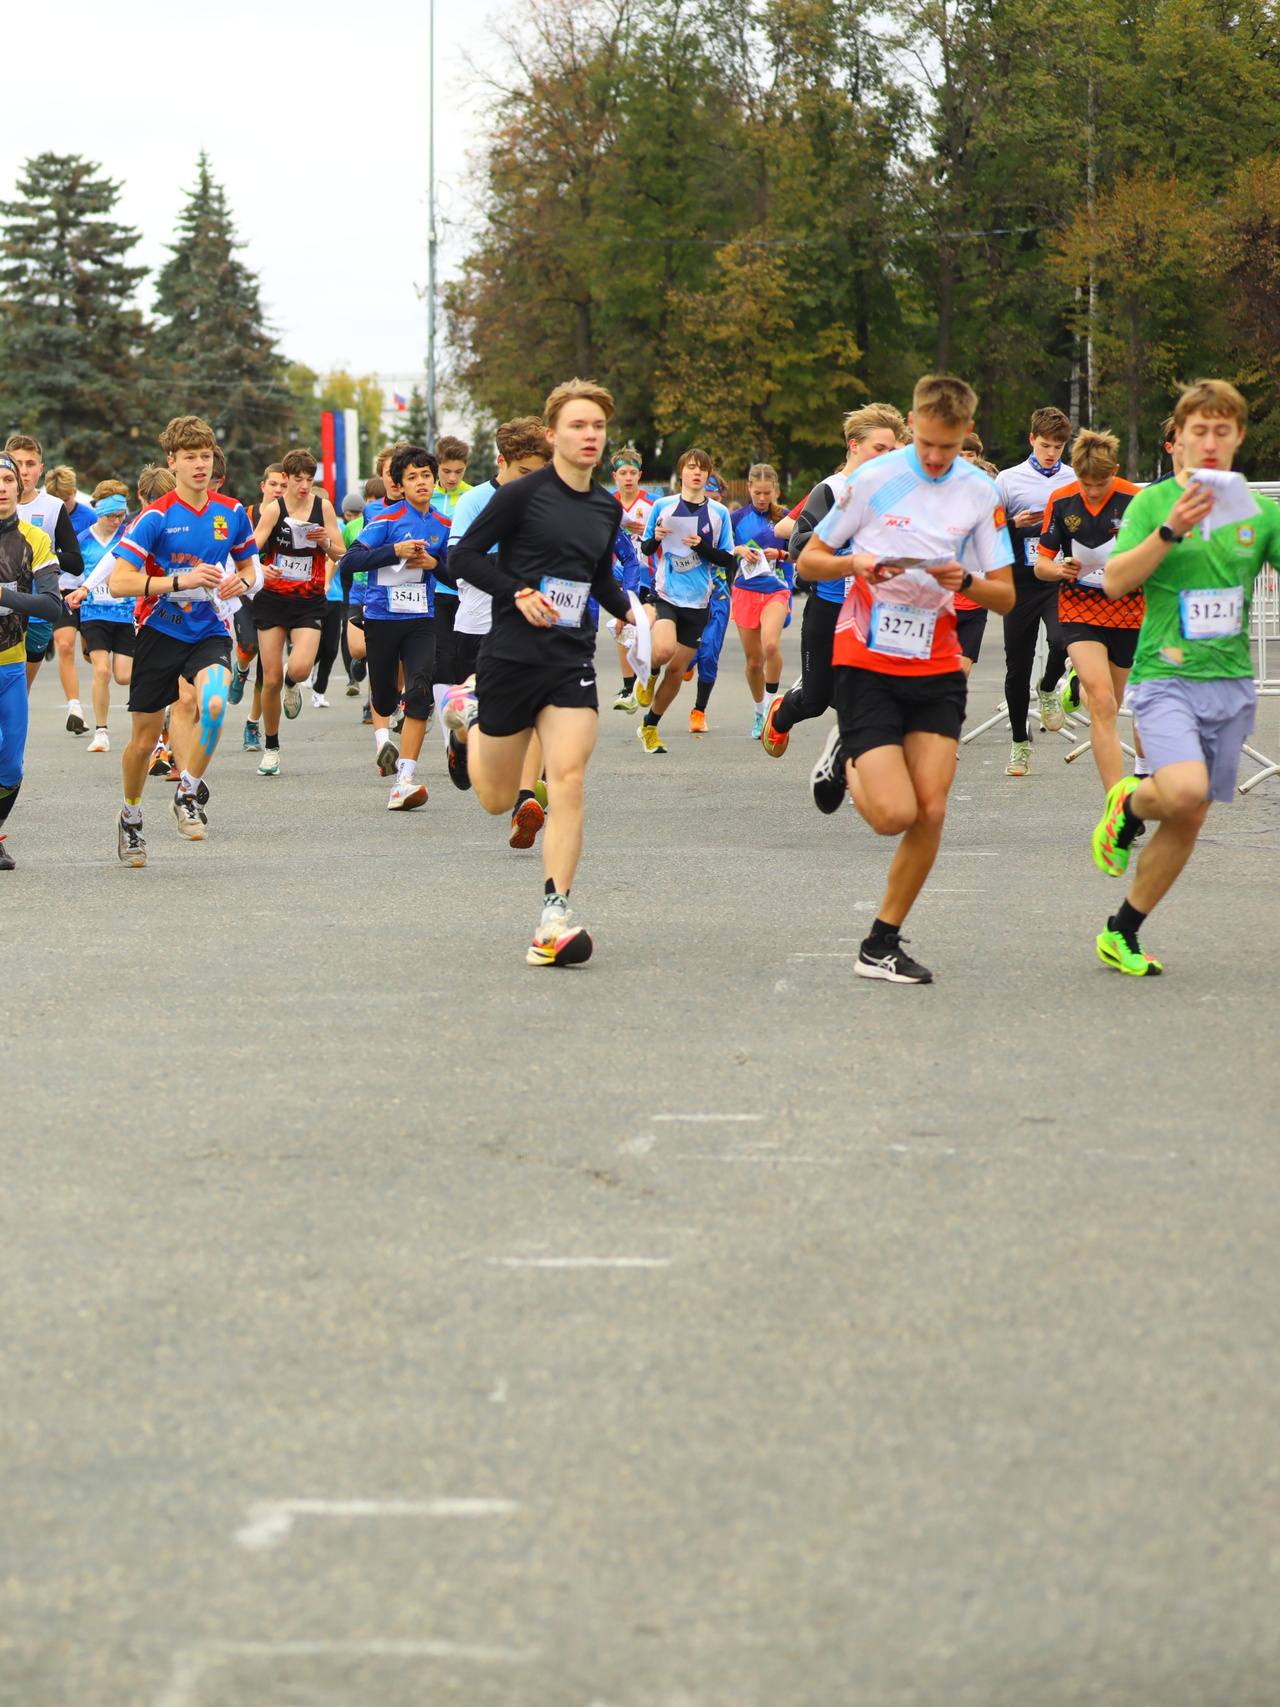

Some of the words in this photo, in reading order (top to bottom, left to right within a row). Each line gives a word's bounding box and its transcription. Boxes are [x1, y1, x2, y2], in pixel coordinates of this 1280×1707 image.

[282, 559, 308, 571] 347.1
[94, 586, 109, 595] 331
[392, 591, 421, 602] 354.1
[548, 589, 582, 610] 308.1
[1189, 602, 1235, 620] 312.1
[171, 613, 183, 625] 18
[879, 616, 926, 638] 327.1
